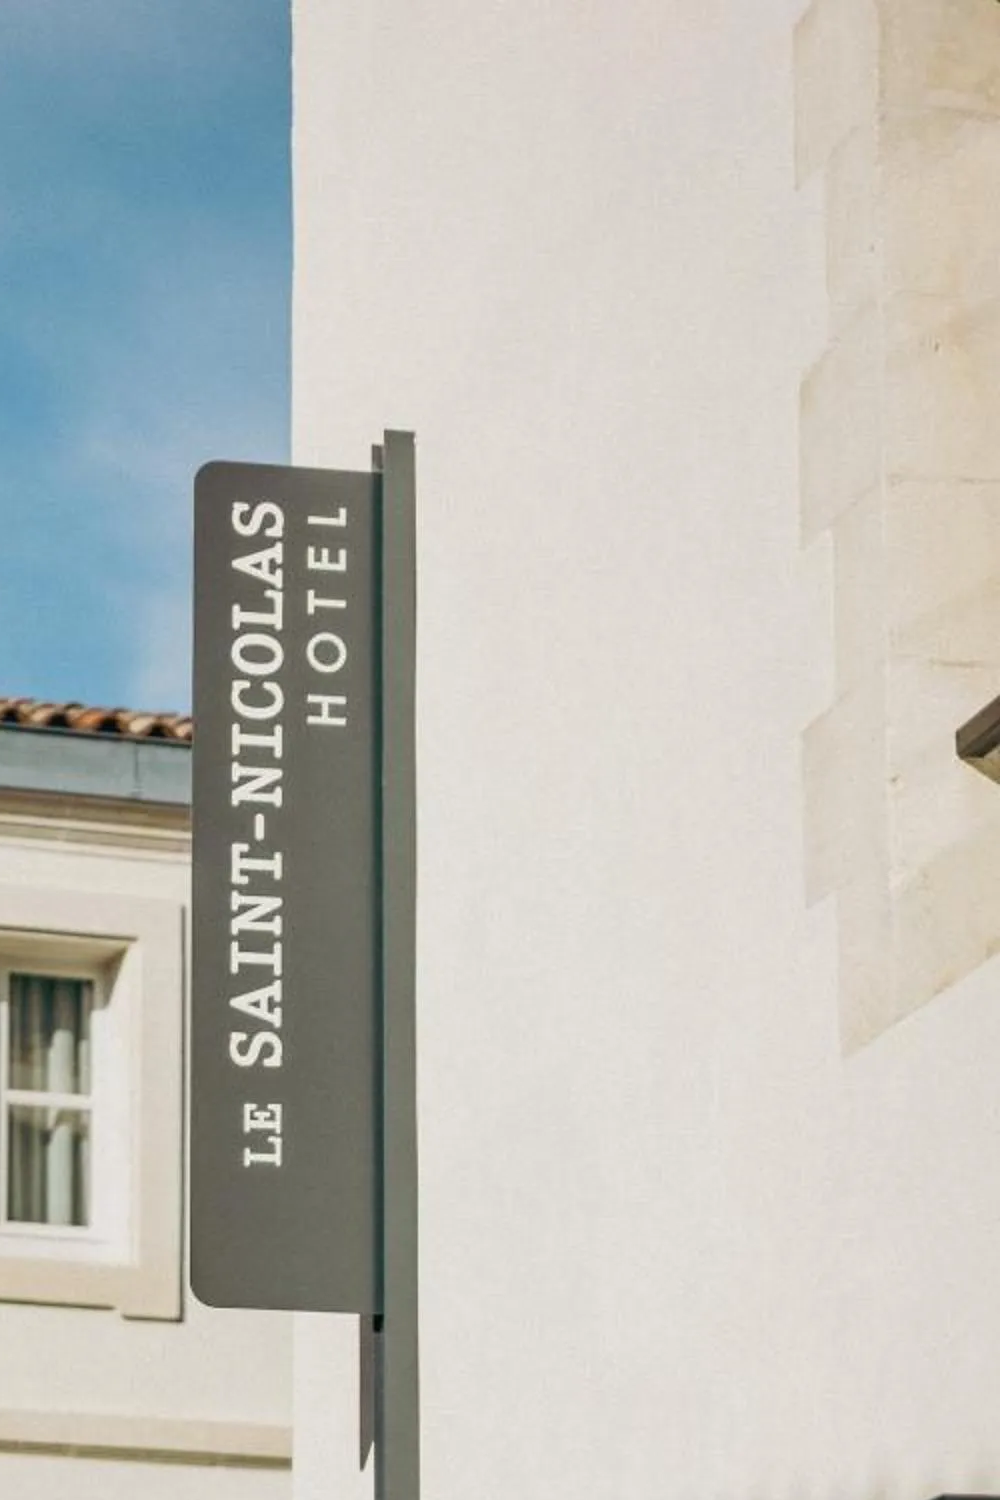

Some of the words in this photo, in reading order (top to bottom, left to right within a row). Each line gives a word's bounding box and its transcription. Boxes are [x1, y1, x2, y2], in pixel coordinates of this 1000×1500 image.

[305, 507, 348, 727] HOTEL
[229, 501, 285, 1068] SAINT-NICOLAS
[243, 1102, 284, 1168] LE
